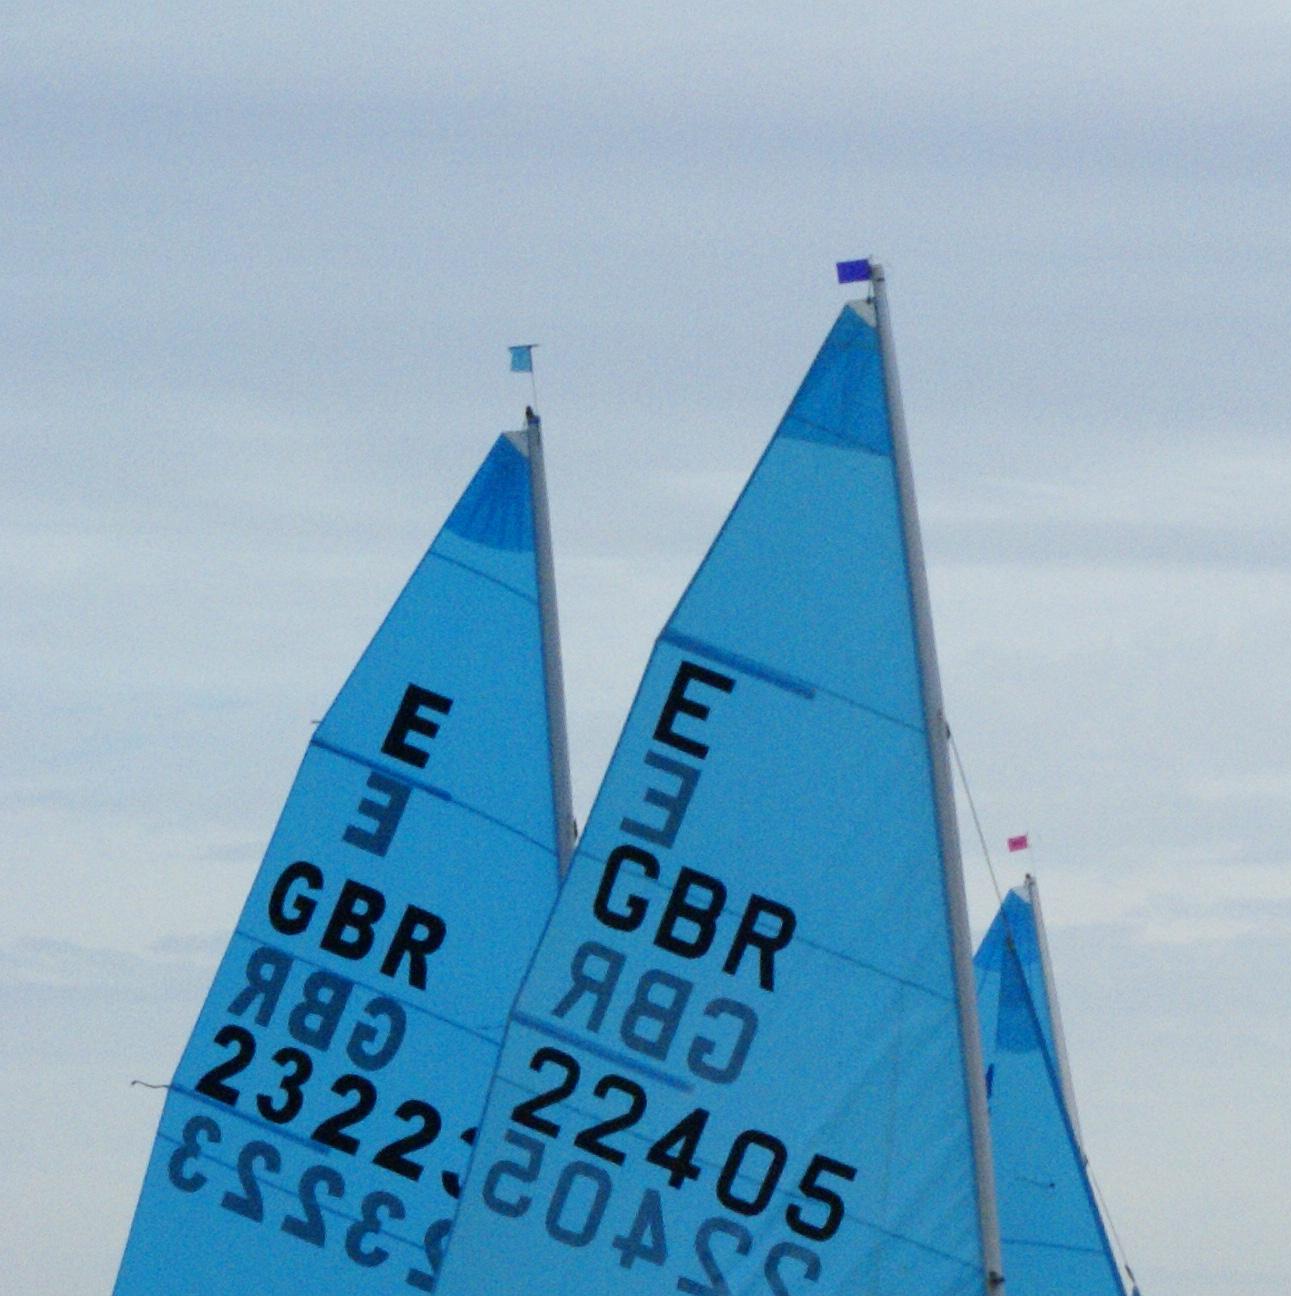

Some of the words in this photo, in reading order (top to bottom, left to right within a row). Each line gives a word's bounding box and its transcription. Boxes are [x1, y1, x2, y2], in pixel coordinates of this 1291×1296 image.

[381, 683, 453, 768] E
[652, 660, 736, 760] E
[269, 861, 446, 990] GBR
[593, 844, 797, 992] GBR
[195, 1025, 478, 1199] 2322
[512, 1046, 858, 1242] 22405
